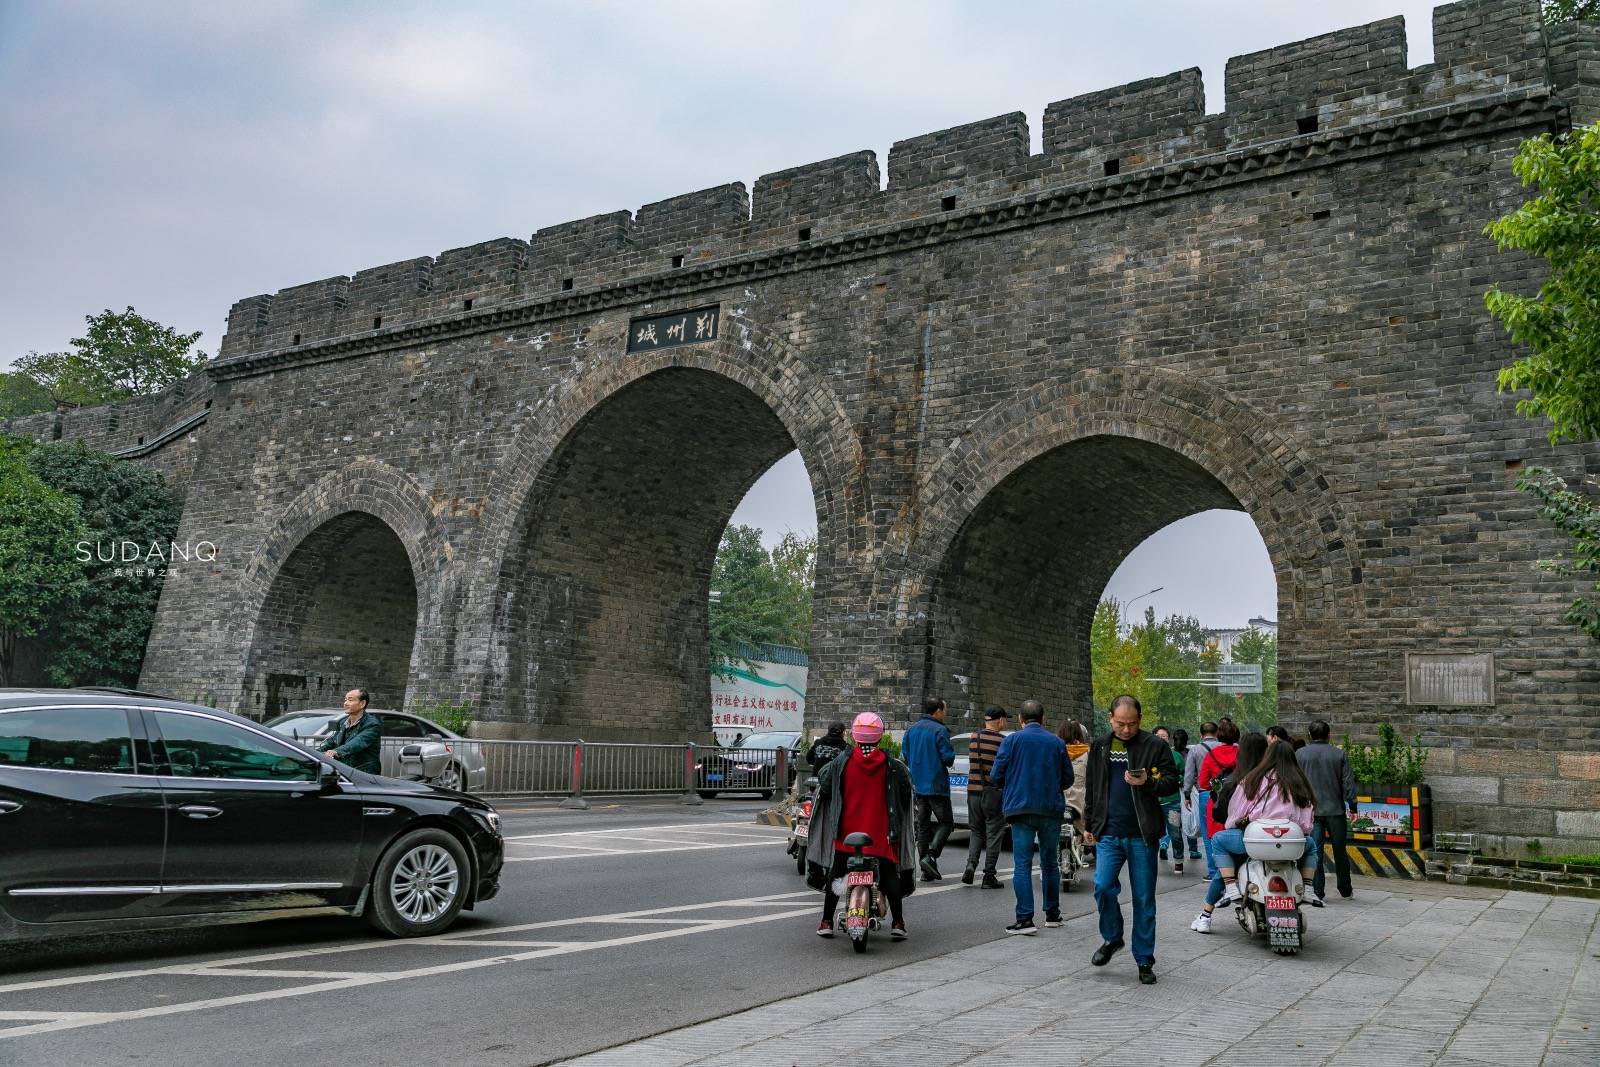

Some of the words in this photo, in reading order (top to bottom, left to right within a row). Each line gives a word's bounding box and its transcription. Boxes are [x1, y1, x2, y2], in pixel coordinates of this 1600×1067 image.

[711, 694, 798, 712] 行社会主义核心价值观
